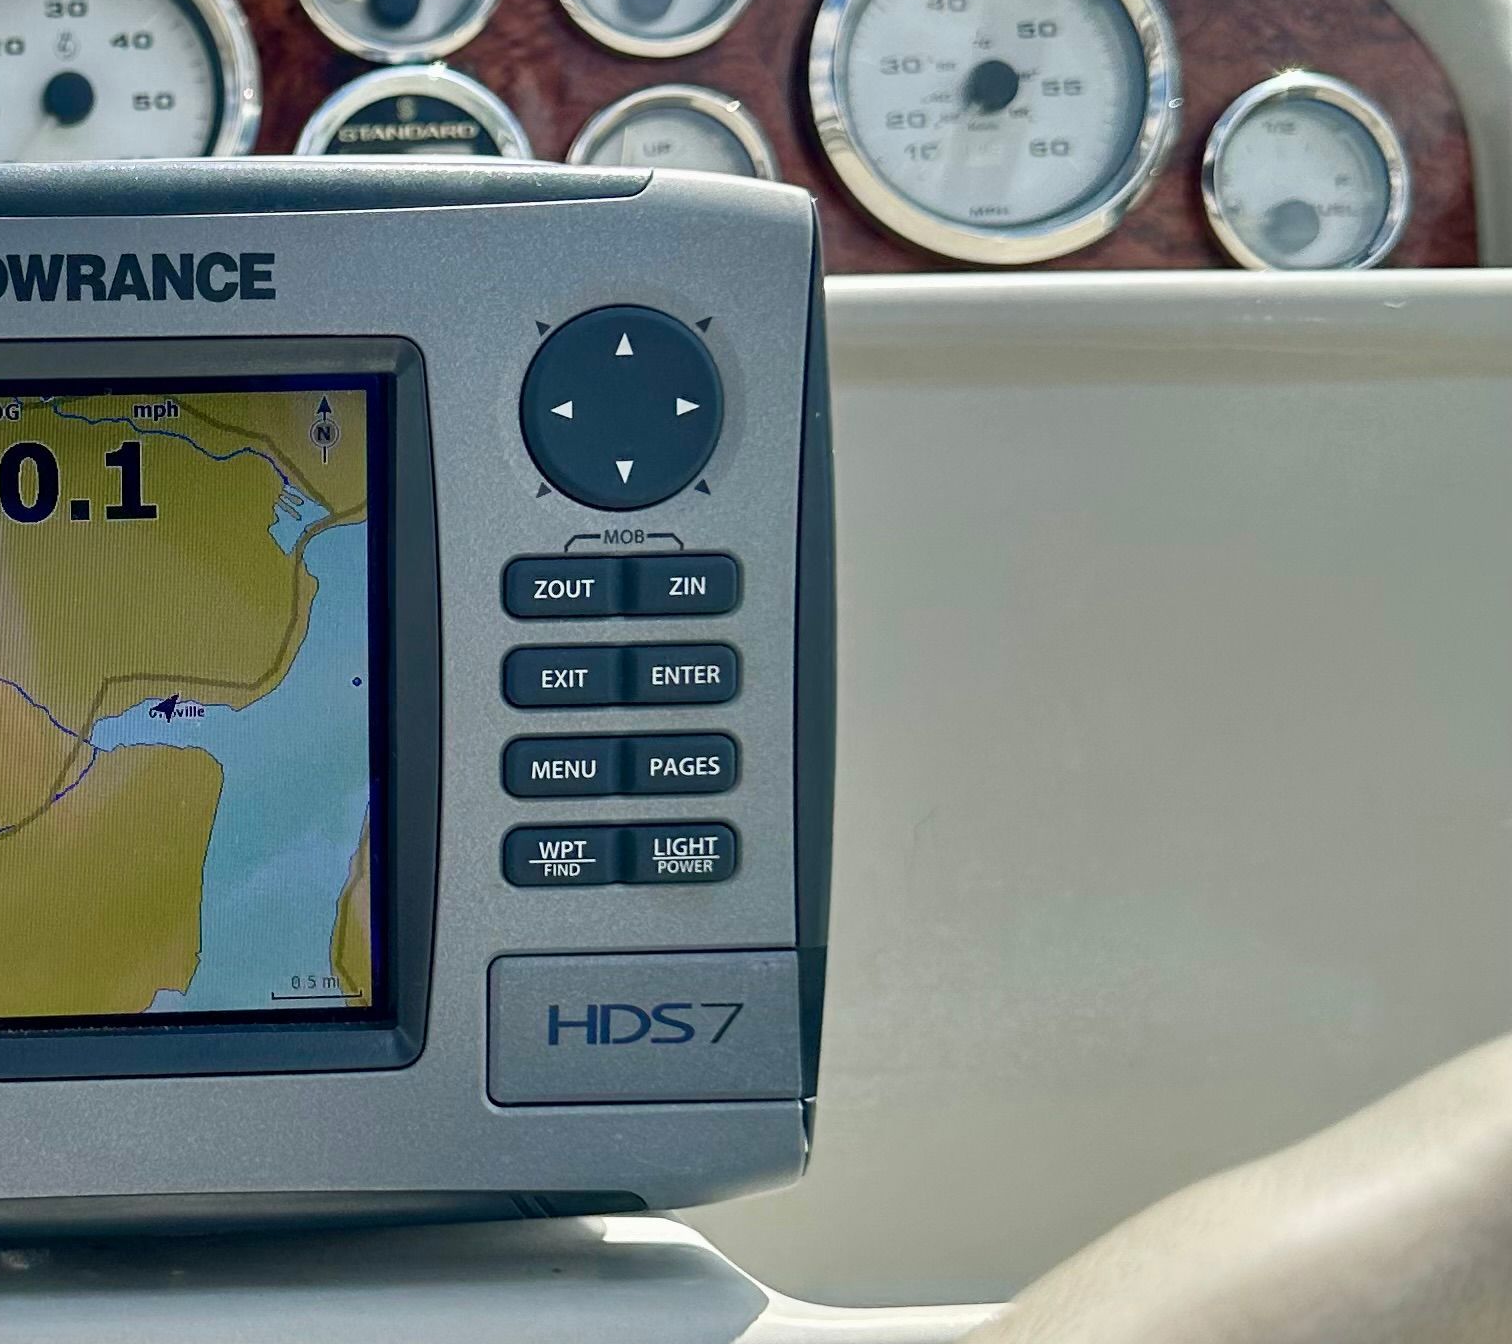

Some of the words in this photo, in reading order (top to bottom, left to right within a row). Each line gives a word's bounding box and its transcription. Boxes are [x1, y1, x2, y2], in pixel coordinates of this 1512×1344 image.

[44, 0, 89, 19] 30
[1017, 20, 1058, 39] 50
[109, 31, 154, 50] 40
[879, 56, 921, 75] 30
[132, 91, 176, 112] 50
[885, 111, 927, 130] 20
[338, 121, 479, 142] STANDARD
[1028, 139, 1070, 158] 60
[133, 400, 180, 422] mph
[603, 529, 646, 545] MOB
[533, 578, 595, 600] ZOUT
[668, 576, 707, 597] ZIN
[541, 668, 589, 689] EXIT
[651, 665, 721, 686] ENTER
[531, 760, 598, 780] MENU
[649, 756, 721, 777] PAGES
[538, 840, 587, 860] WPT
[653, 837, 719, 857] LIGHT
[543, 862, 582, 877] FIND
[657, 858, 714, 874] POWER
